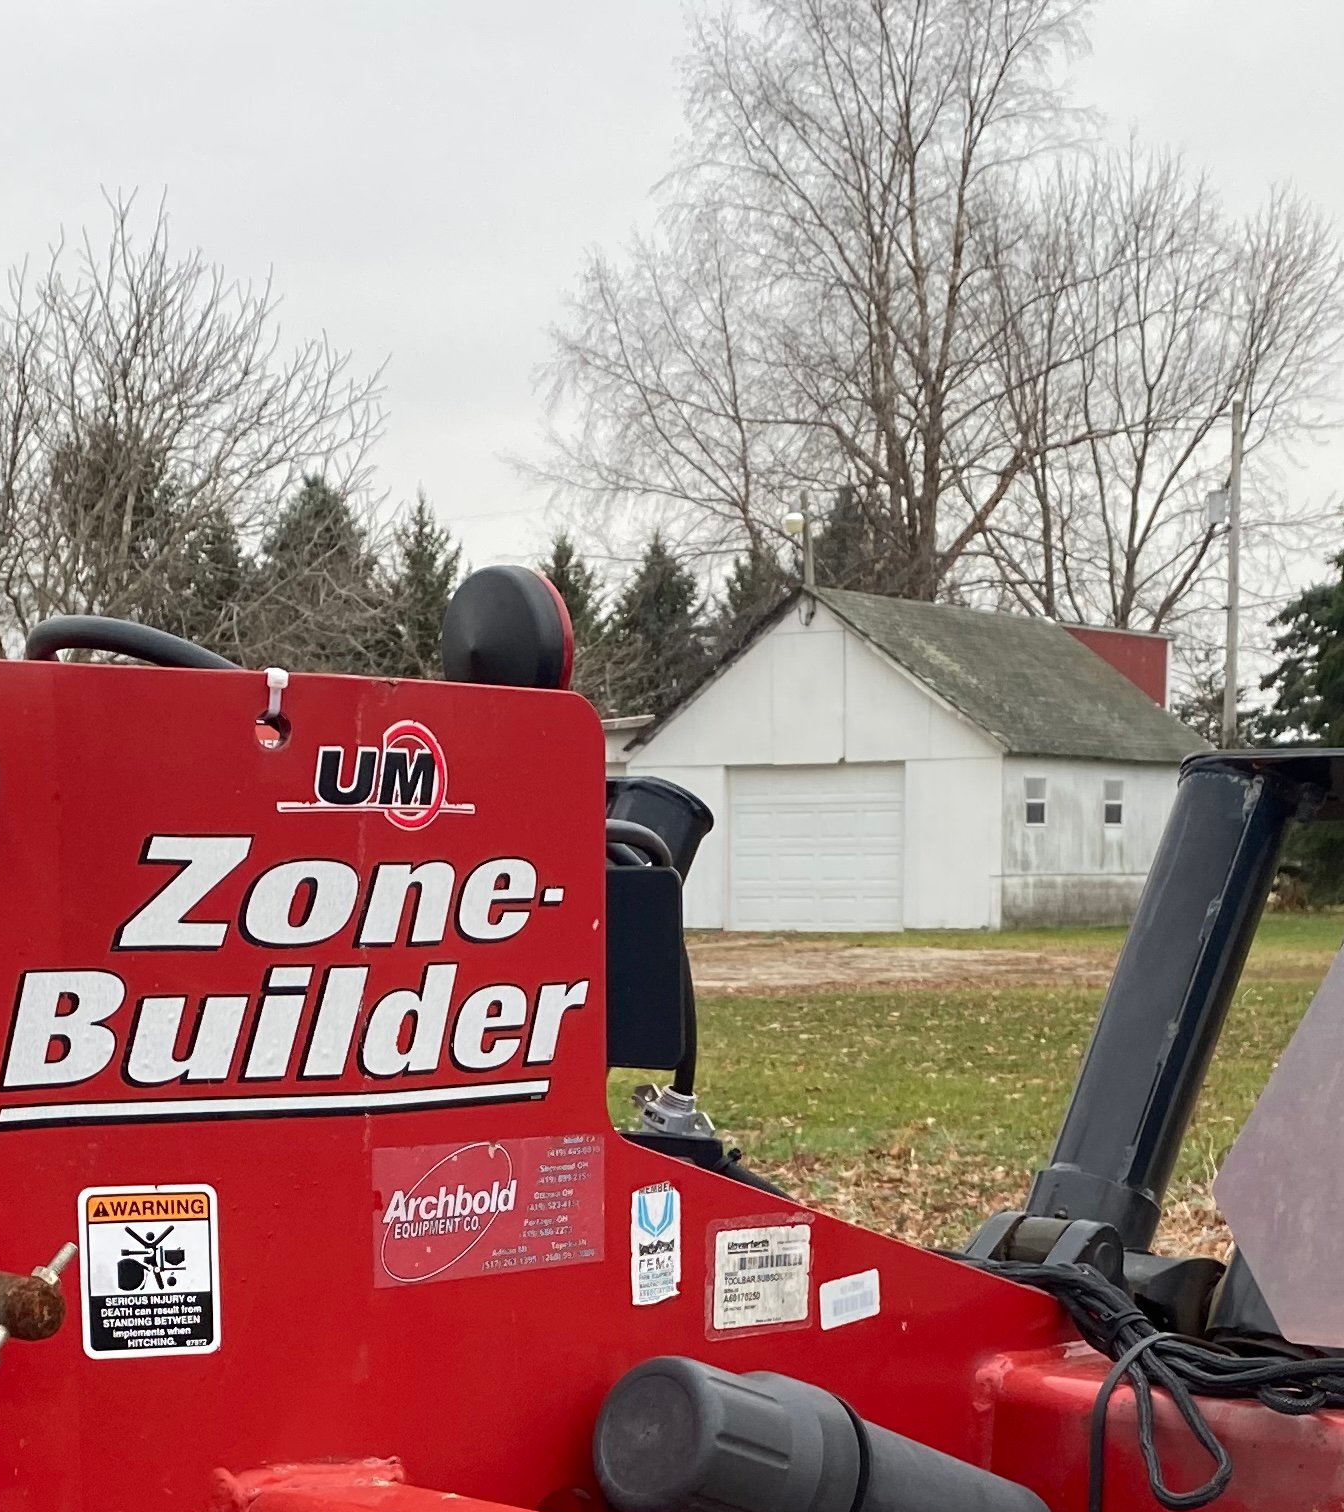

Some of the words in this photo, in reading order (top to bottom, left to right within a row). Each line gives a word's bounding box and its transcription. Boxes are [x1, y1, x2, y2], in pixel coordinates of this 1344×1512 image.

[314, 746, 438, 806] UM
[112, 833, 564, 952] Zone-
[110, 1199, 204, 1217] WARNING
[382, 1179, 518, 1224] Archbold
[394, 1217, 463, 1239] EQUIPMENT
[463, 1216, 481, 1232] CO.
[105, 1296, 148, 1306] SERIOUS
[150, 1294, 185, 1305] INJURY
[187, 1295, 197, 1303] or
[100, 1307, 132, 1317] DEATH
[134, 1308, 151, 1316] can
[153, 1306, 179, 1315] result
[181, 1305, 202, 1314] from
[103, 1317, 152, 1328] STANDING
[154, 1315, 200, 1325] BETWEEN
[112, 1329, 165, 1339] implements
[167, 1327, 192, 1336] when
[127, 1337, 177, 1348] HITCHING.
